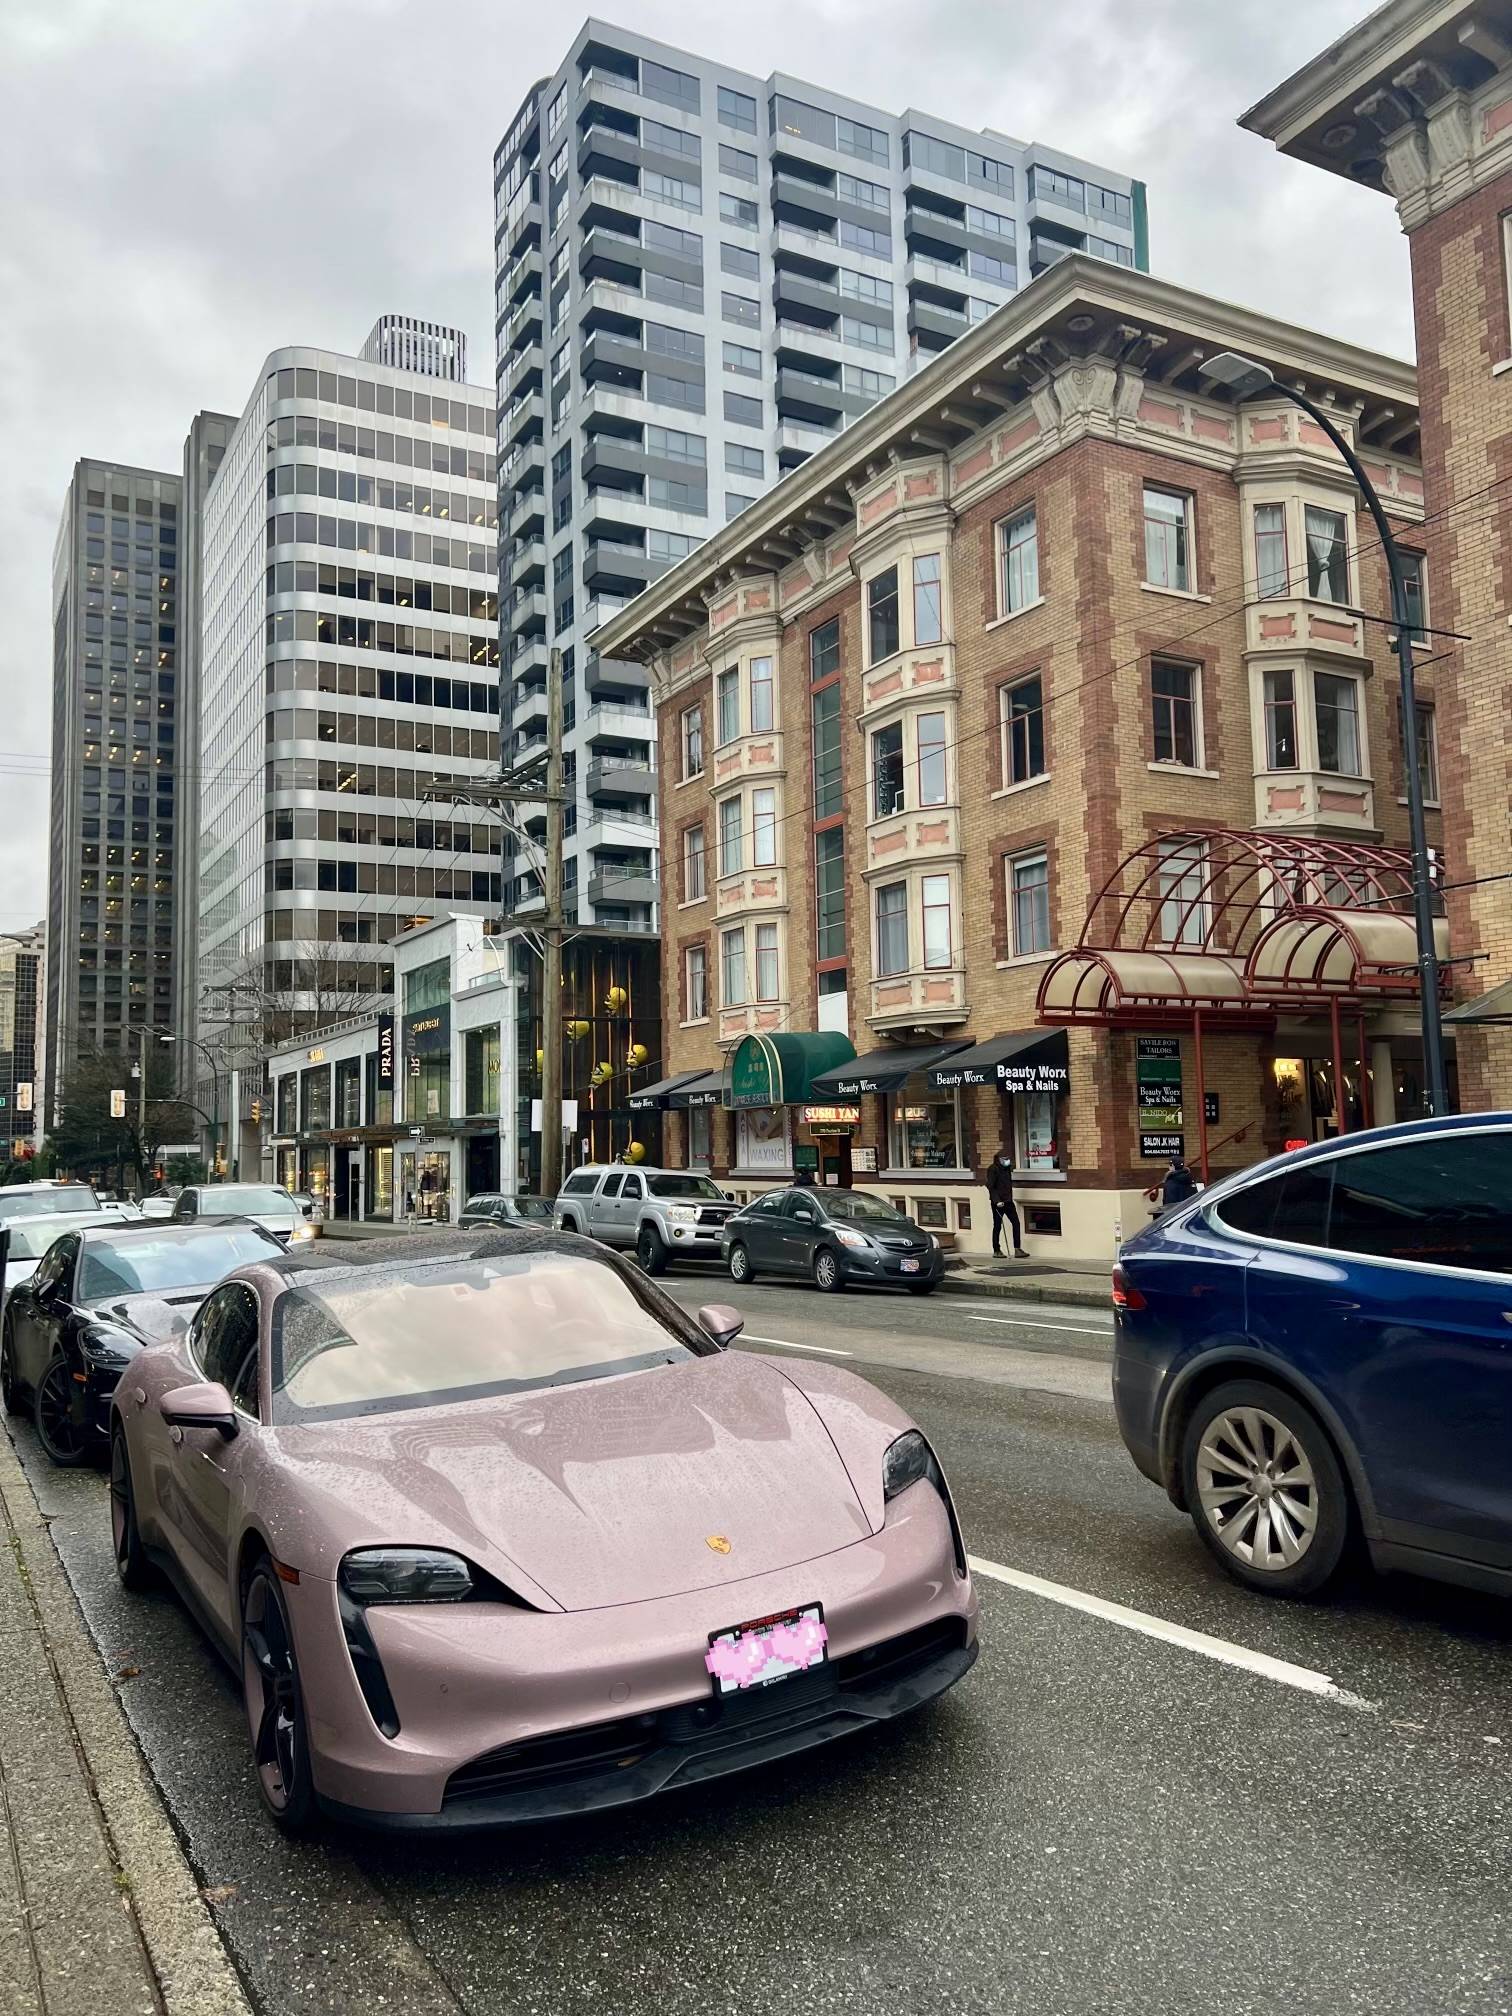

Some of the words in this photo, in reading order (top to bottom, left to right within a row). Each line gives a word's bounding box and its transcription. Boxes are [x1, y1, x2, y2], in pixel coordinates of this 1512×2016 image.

[381, 1027, 392, 1077] PRADA
[936, 1072, 962, 1086] Beauty
[963, 1070, 985, 1083] Worx
[997, 1065, 1036, 1080] Beauty
[1038, 1065, 1067, 1079] Worx
[838, 1081, 859, 1095] Beauty
[859, 1079, 877, 1092] Worx
[1005, 1080, 1024, 1093] Spa
[1026, 1080, 1034, 1091] &
[1035, 1080, 1059, 1091] Nails
[1140, 1086, 1161, 1097] Beauty
[1162, 1086, 1181, 1096] Worx
[1145, 1096, 1155, 1105] Spa
[804, 1107, 836, 1119] SUSHI
[838, 1107, 860, 1119] YAN
[1151, 1109, 1168, 1117] NIDO
[1143, 1136, 1161, 1147] SALON
[1161, 1137, 1168, 1147] JK
[1168, 1137, 1180, 1147] HAIR
[751, 1148, 784, 1162] WAXING
[741, 1608, 798, 1631] PORSCHE
